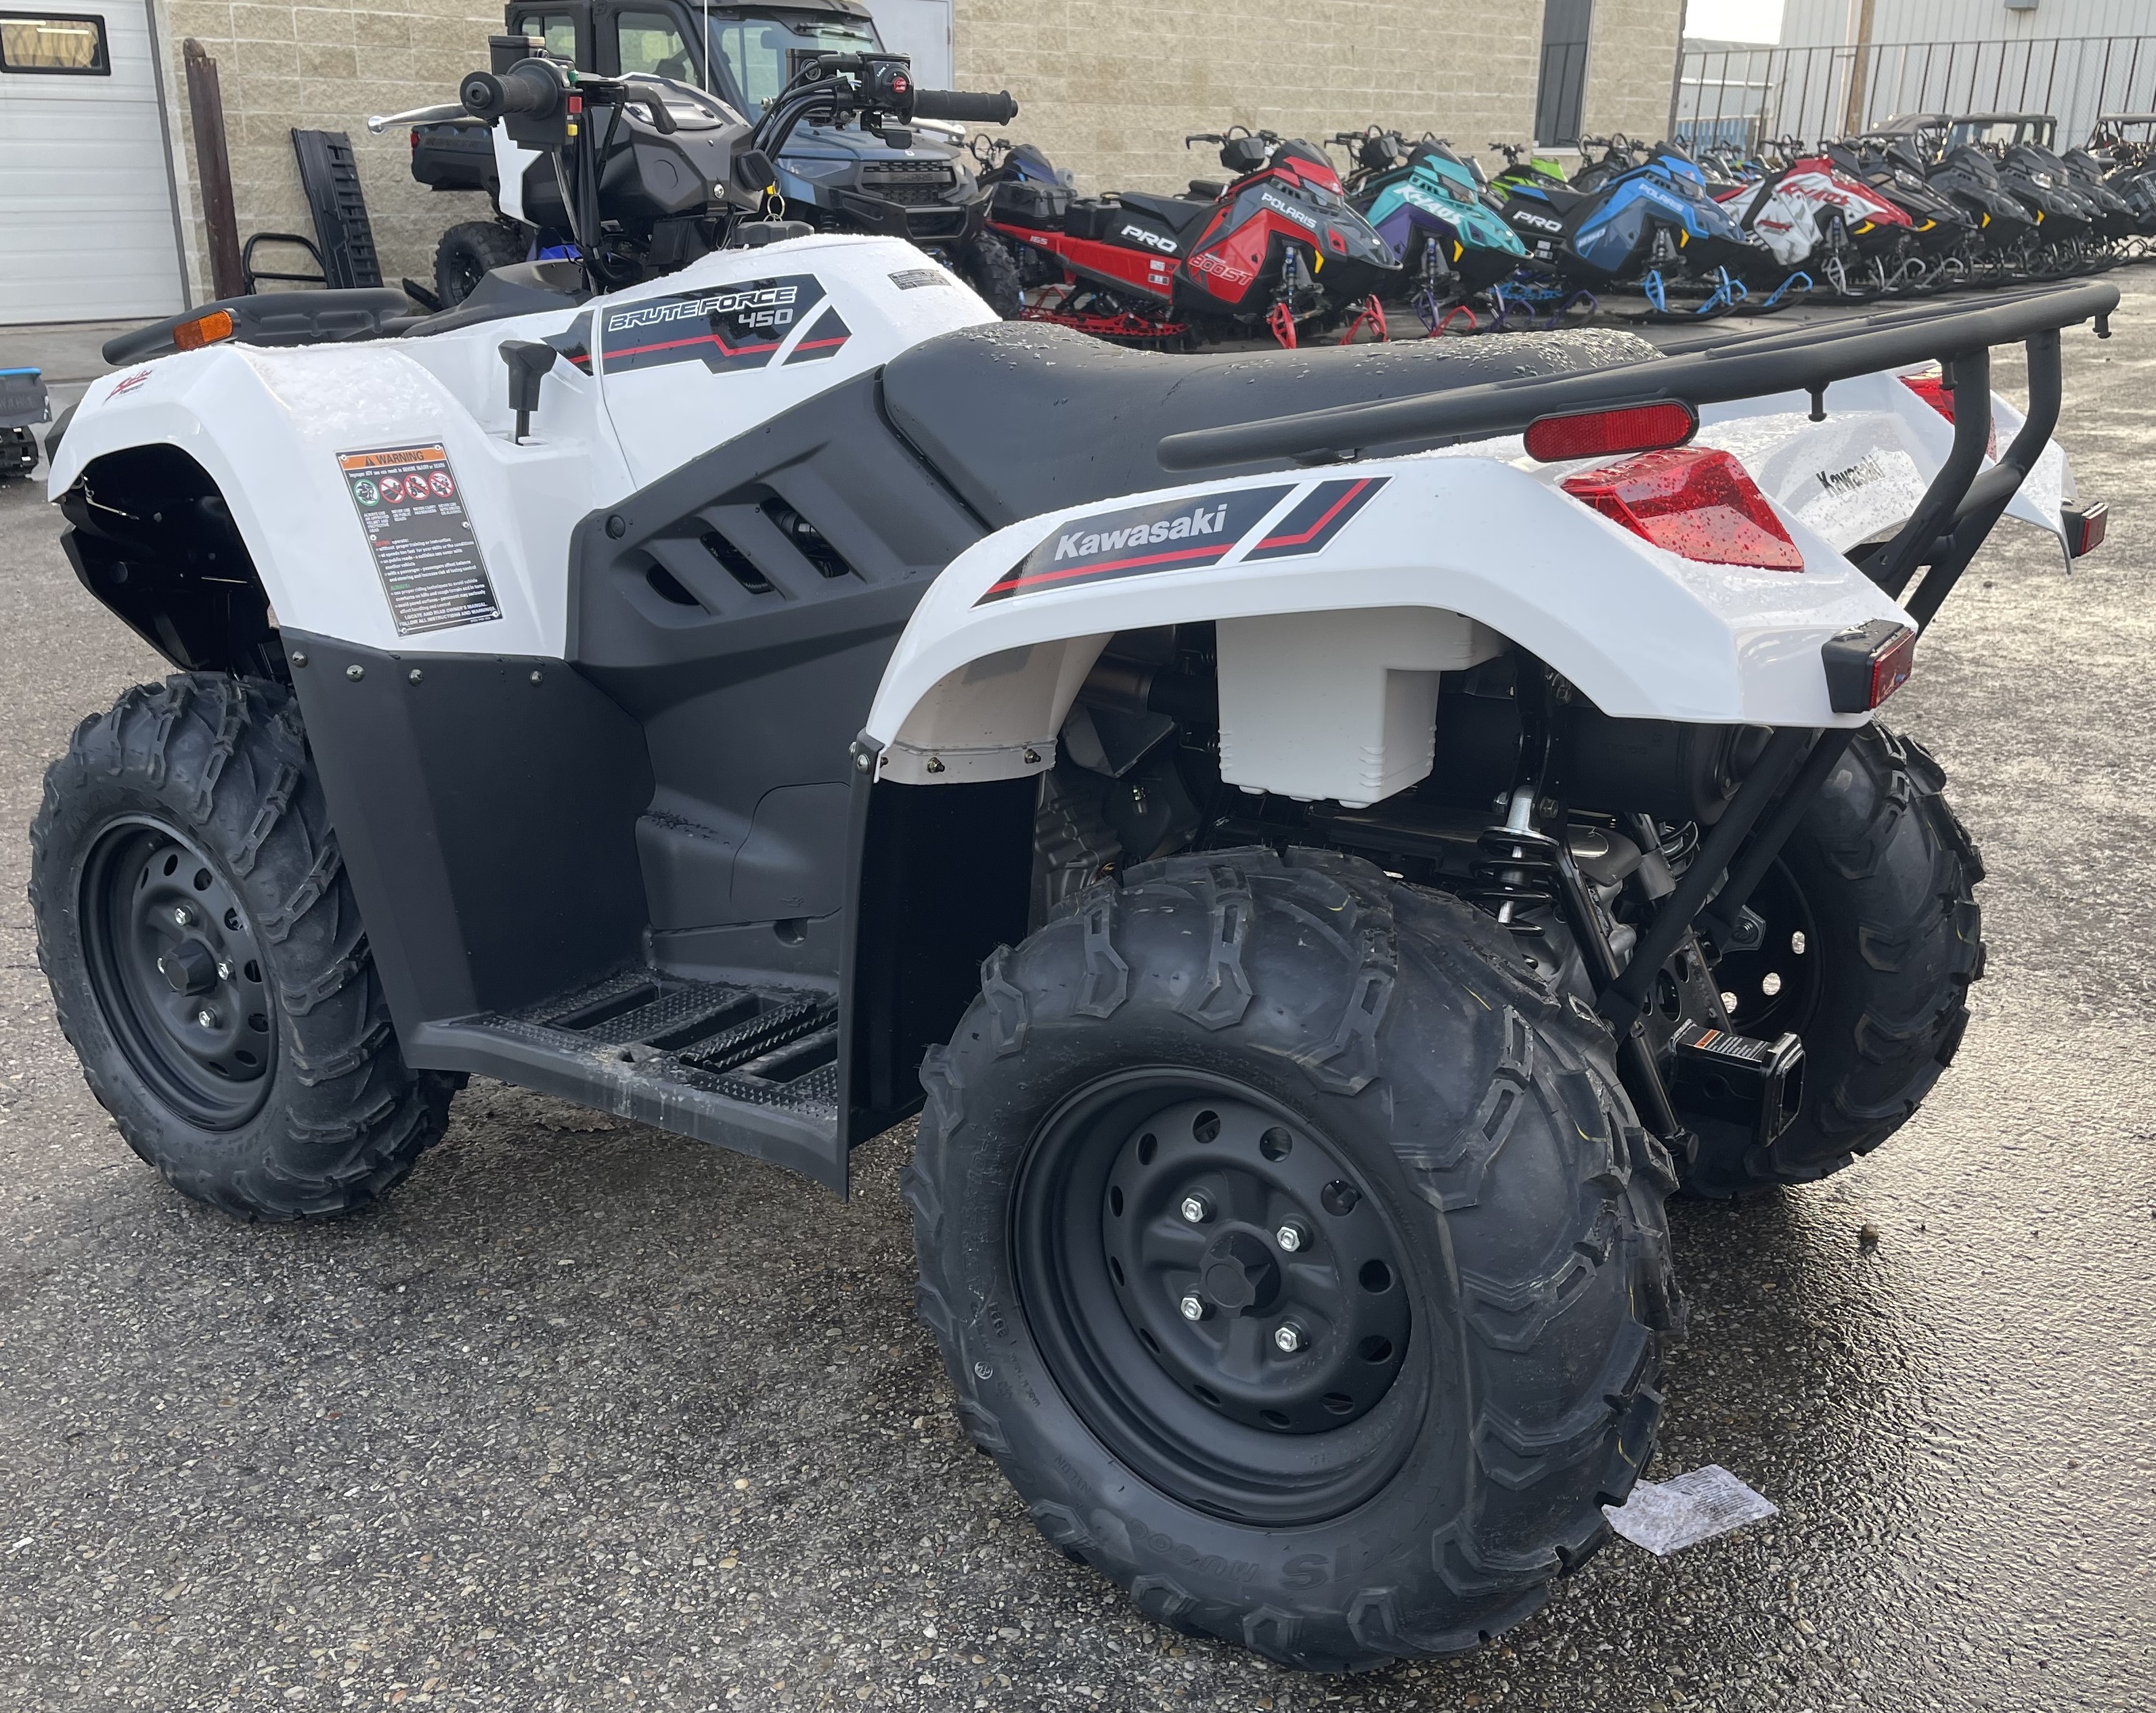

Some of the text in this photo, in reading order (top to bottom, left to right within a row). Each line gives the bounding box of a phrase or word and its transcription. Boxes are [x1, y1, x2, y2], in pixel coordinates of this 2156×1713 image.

[1261, 192, 1317, 228] POLARIS
[1392, 184, 1466, 224] KHAOS
[1639, 183, 1684, 211] POLARIS
[1512, 210, 1562, 232] PRO
[1030, 236, 1048, 245] 165
[1121, 223, 1177, 252] PRO
[1188, 254, 1254, 286] BOOST
[609, 286, 797, 332] BRUTE FORCE
[738, 308, 793, 328] 450
[376, 451, 424, 465] WARNING
[1816, 454, 1886, 499] Kawasaki
[1054, 504, 1227, 561] Kawasaki
[428, 613, 460, 621] INSTRUCTIONS
